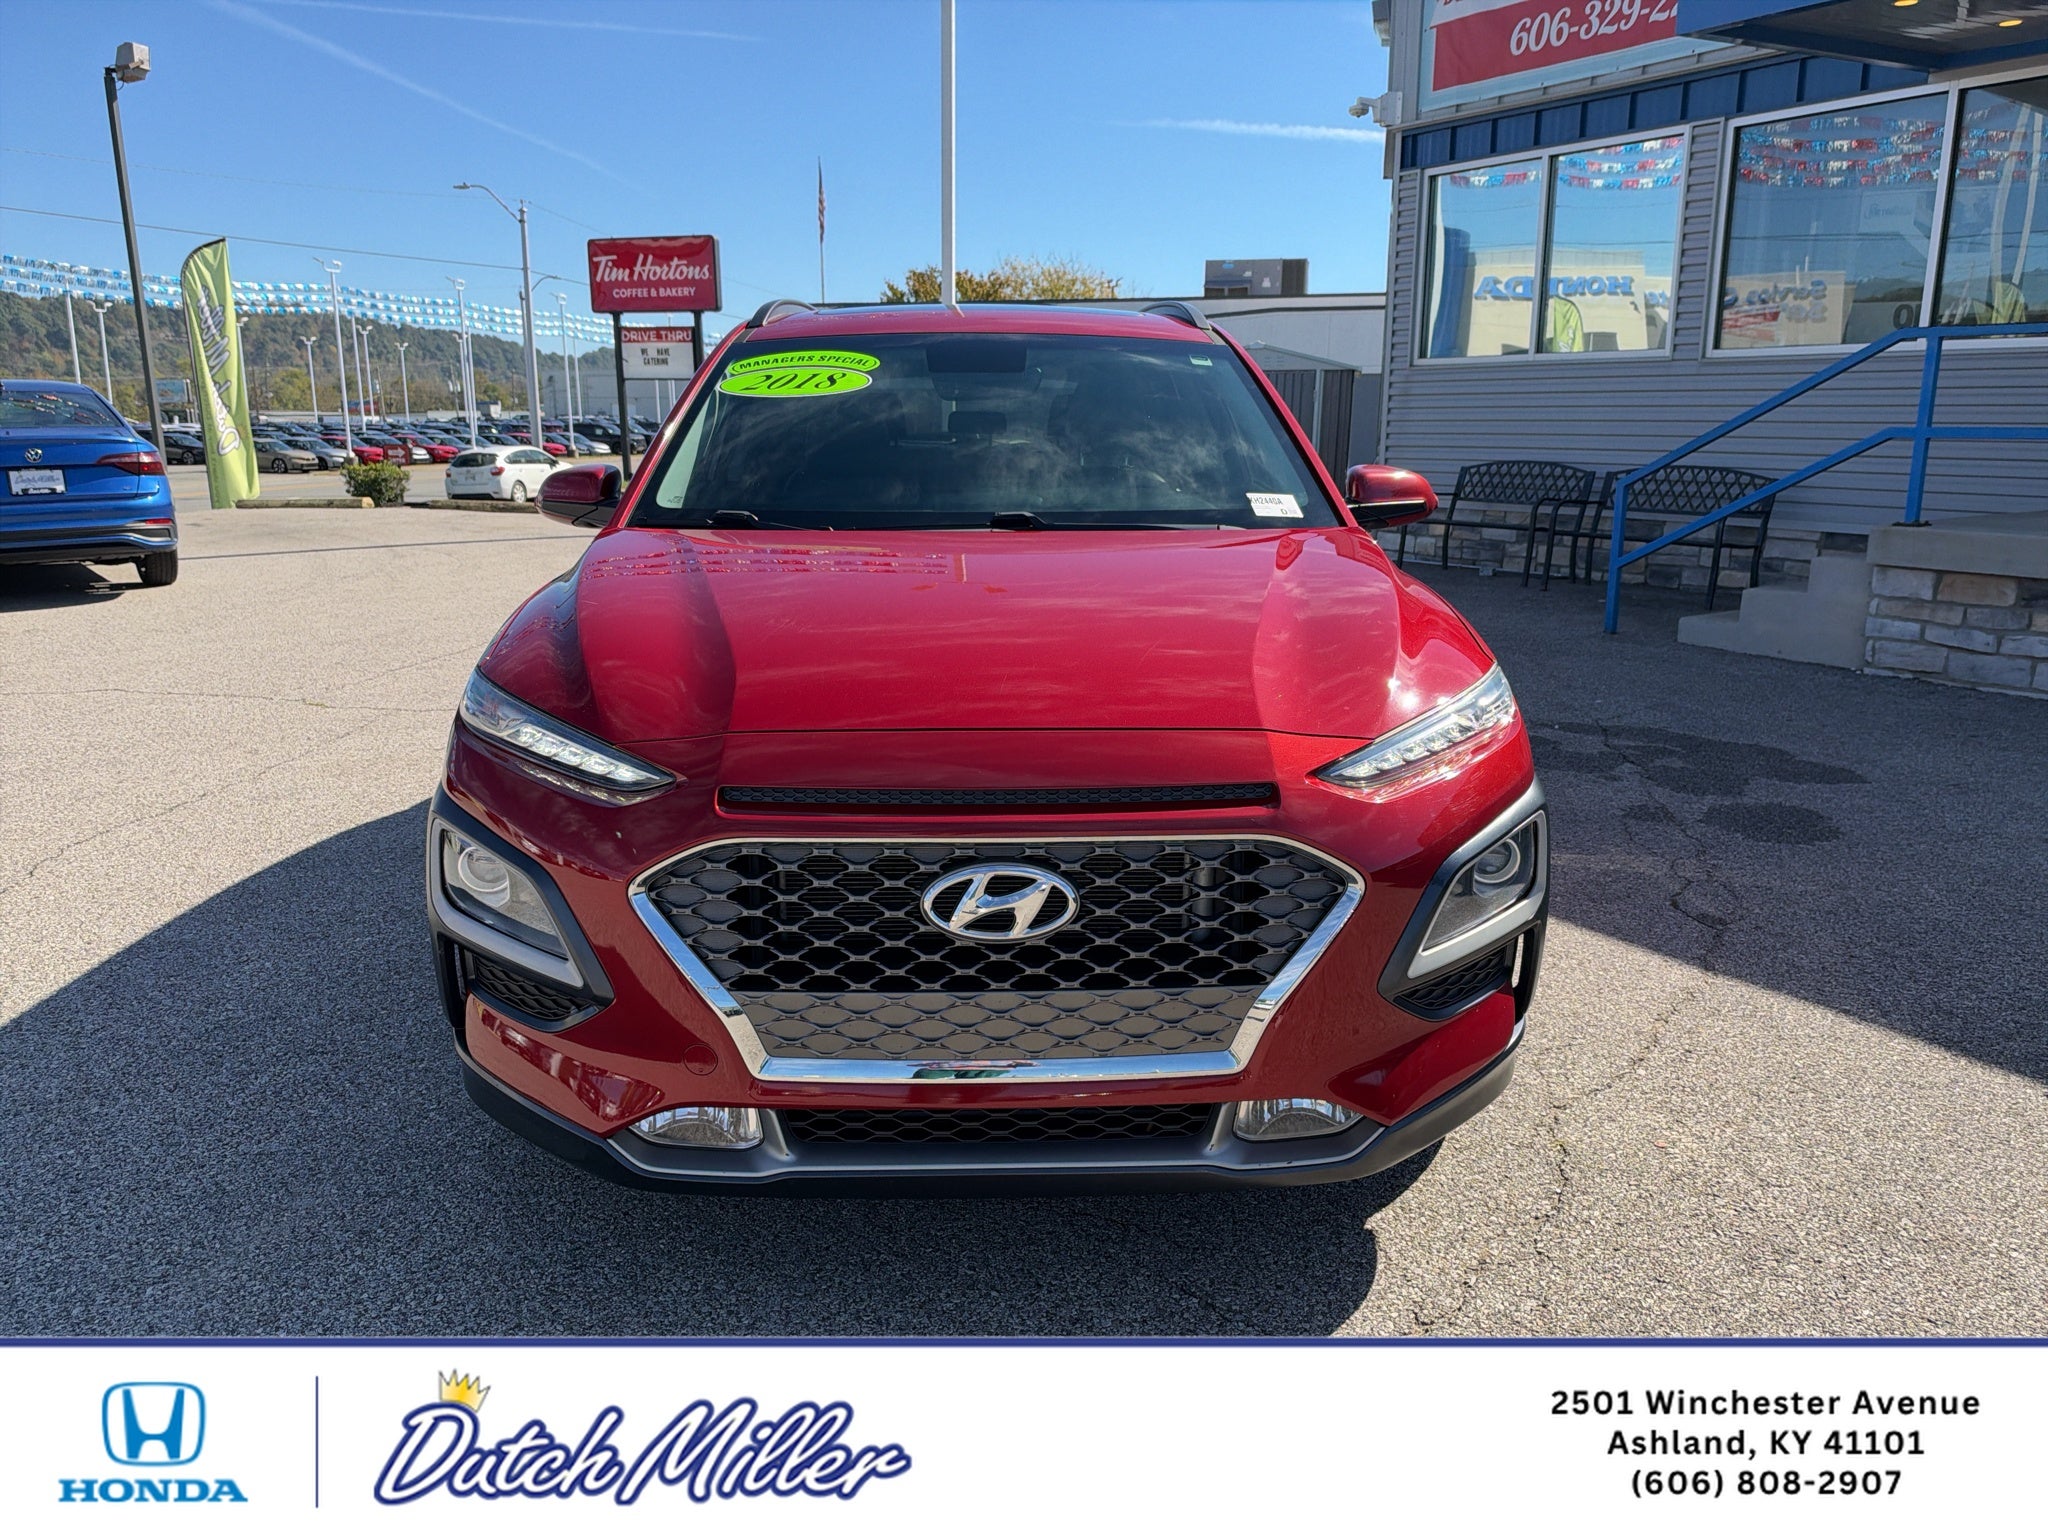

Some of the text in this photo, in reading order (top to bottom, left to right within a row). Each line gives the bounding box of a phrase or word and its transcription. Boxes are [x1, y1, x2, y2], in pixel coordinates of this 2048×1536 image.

[592, 253, 710, 282] Tim Hortons
[612, 286, 696, 299] COFFEE & BAKERY
[621, 329, 692, 342] DRIVE THRU
[656, 348, 670, 356] HAVE
[643, 357, 669, 366] CATERING
[739, 355, 870, 370] MANAGERS SPECIAL
[740, 372, 847, 391] 2018
